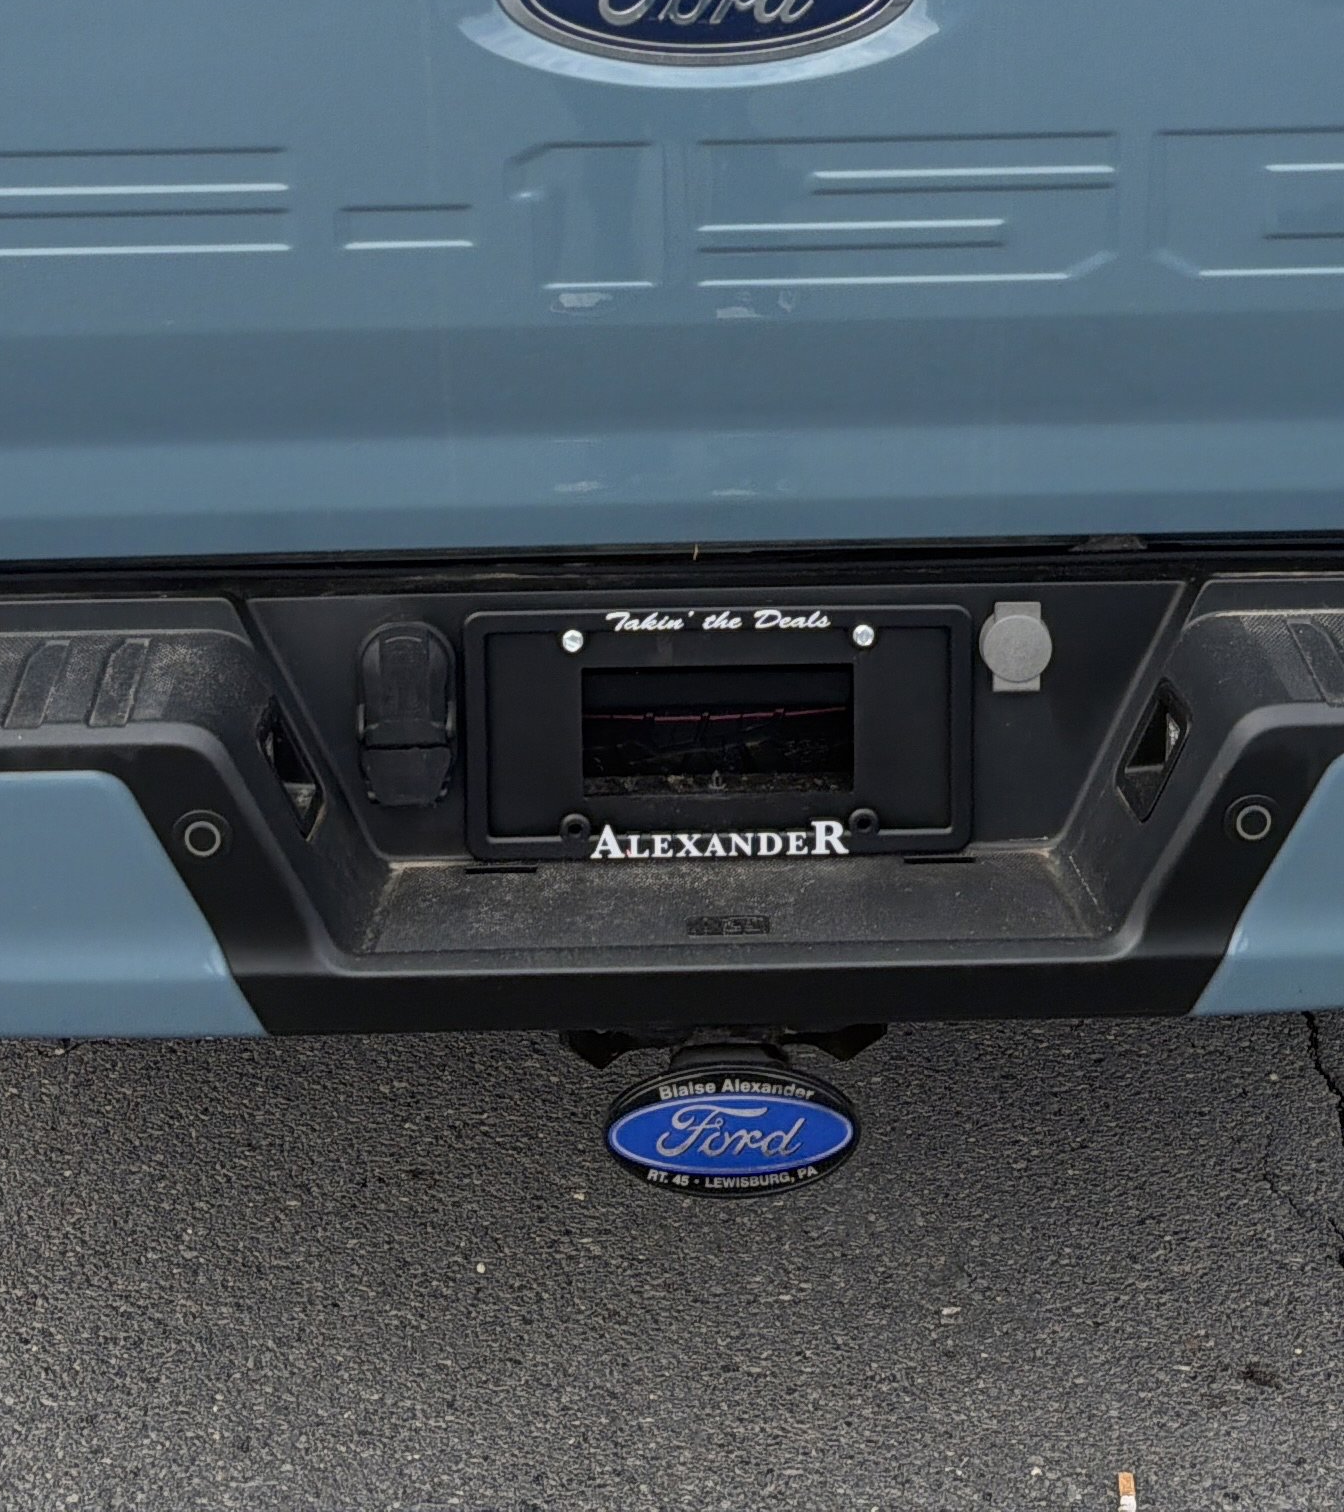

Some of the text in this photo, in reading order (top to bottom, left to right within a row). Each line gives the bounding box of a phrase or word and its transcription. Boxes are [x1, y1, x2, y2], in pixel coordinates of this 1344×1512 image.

[605, 609, 831, 632] Takin' the Deals
[658, 1078, 815, 1101] Blaise Alexander
[656, 1104, 806, 1157] Ford
[647, 1166, 819, 1189] RT. 45 LEWISBURG, PA
